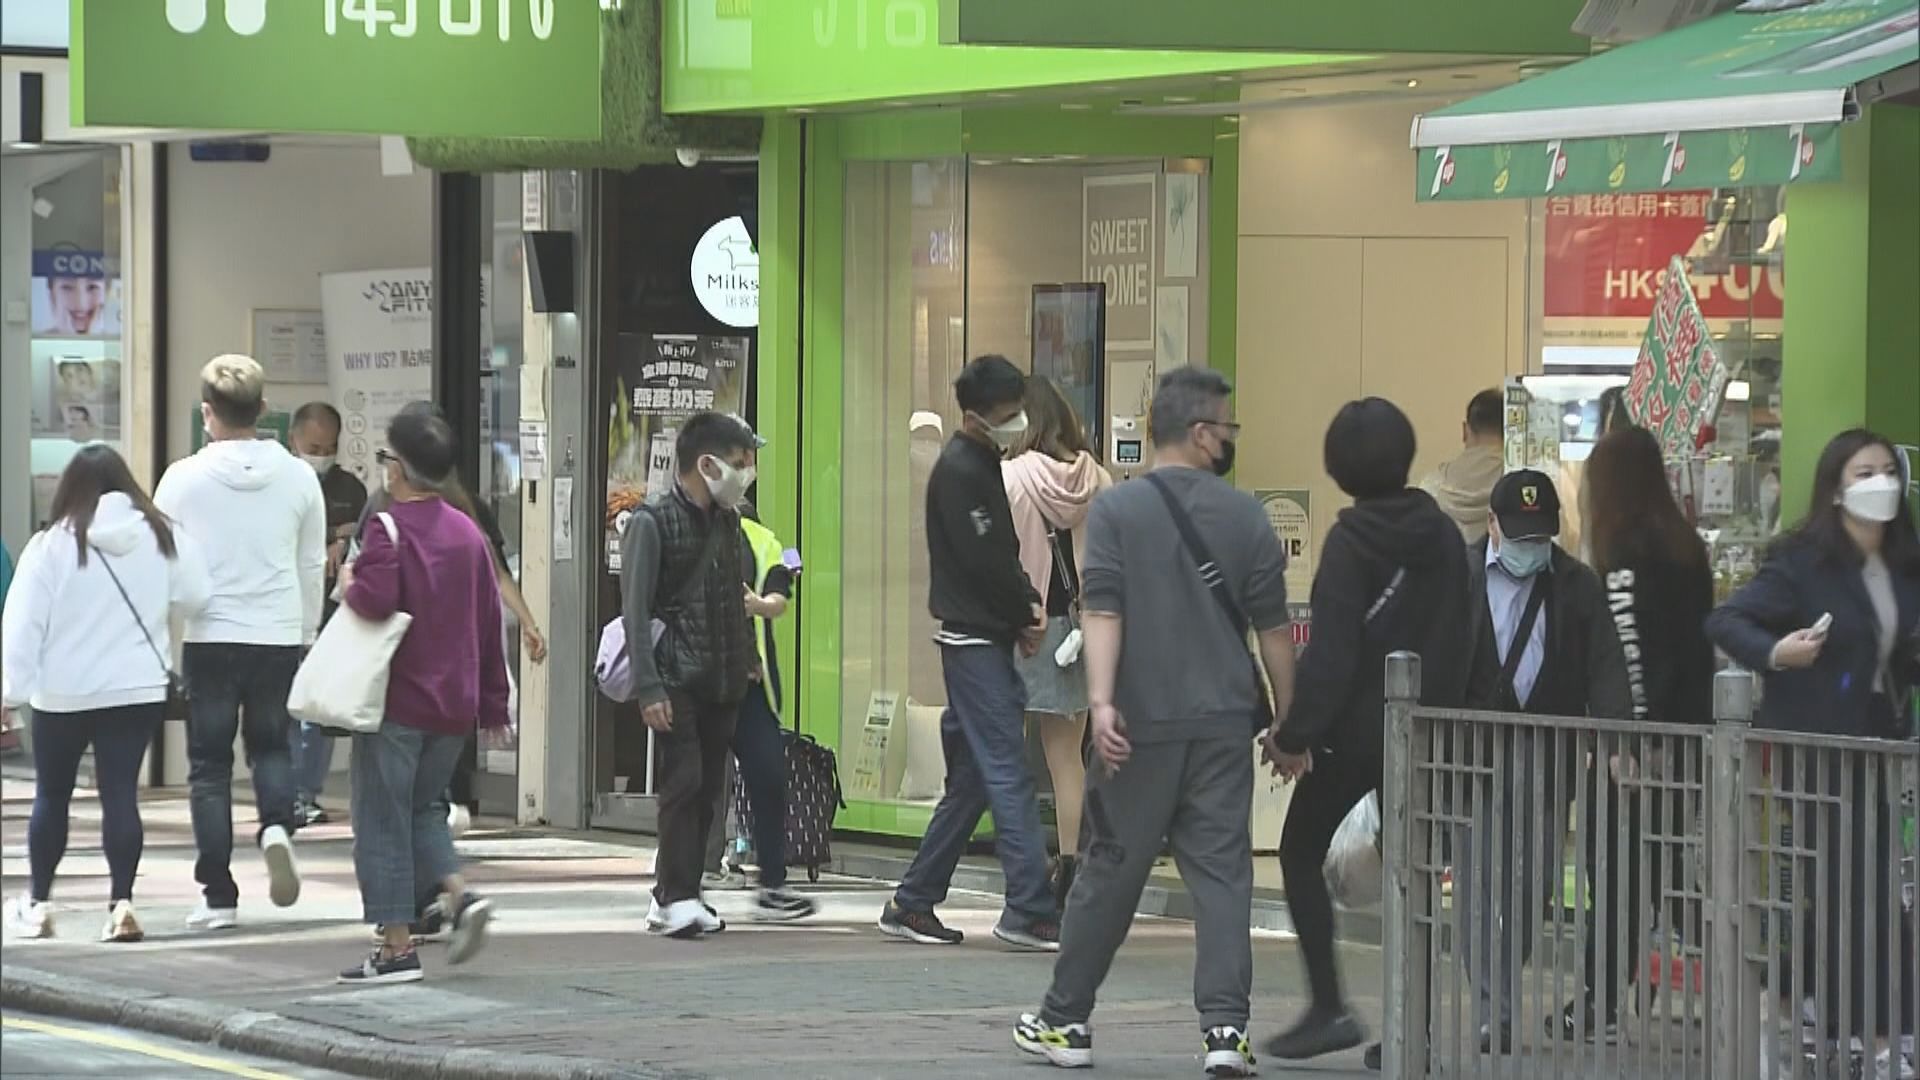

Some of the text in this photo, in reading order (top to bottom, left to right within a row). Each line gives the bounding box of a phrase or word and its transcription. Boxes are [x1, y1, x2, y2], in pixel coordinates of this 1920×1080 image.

[1090, 218, 1148, 255] SWEET
[343, 351, 371, 371] WHY
[374, 350, 397, 369] US?
